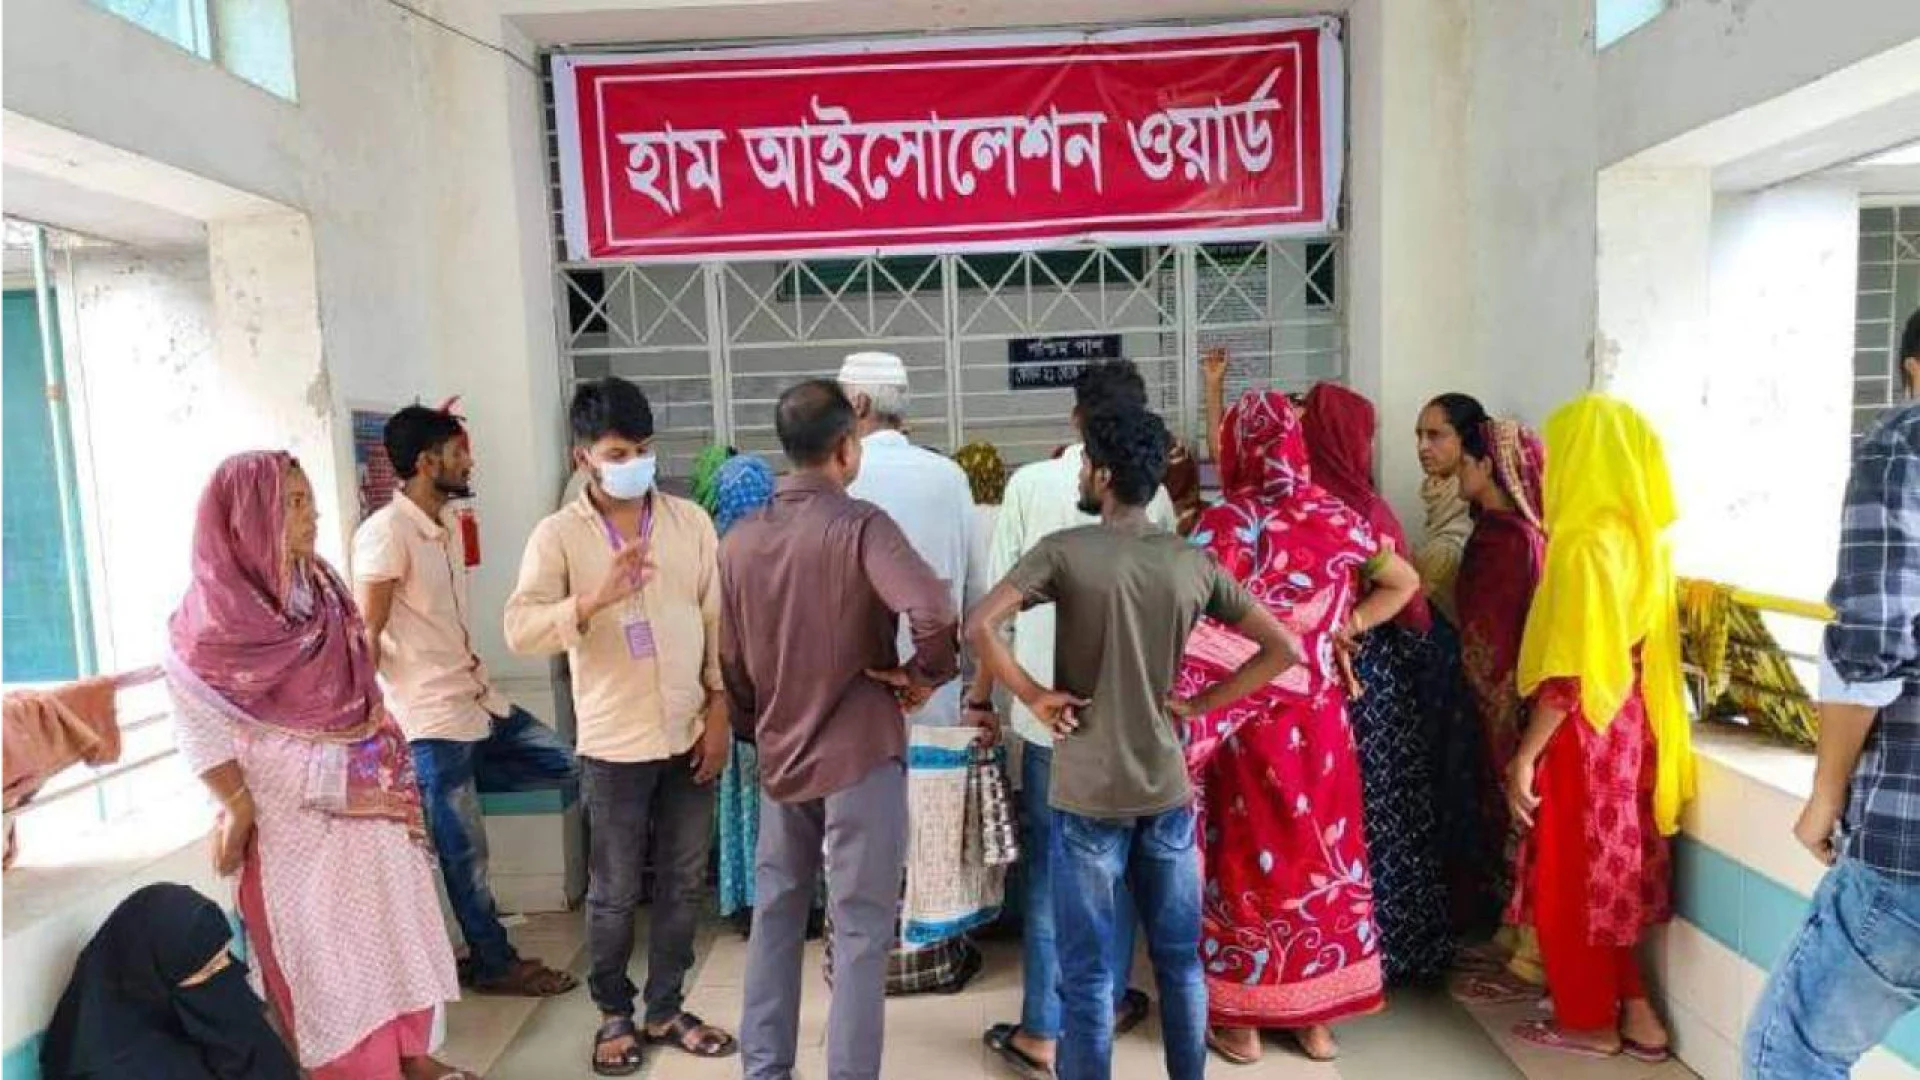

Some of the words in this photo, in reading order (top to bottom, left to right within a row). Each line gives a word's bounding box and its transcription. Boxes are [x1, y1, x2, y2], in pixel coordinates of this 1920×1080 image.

[617, 124, 727, 215] হাম
[739, 94, 1108, 206] আইসোলেশন
[1127, 67, 1282, 184] ওয়ার্ড
